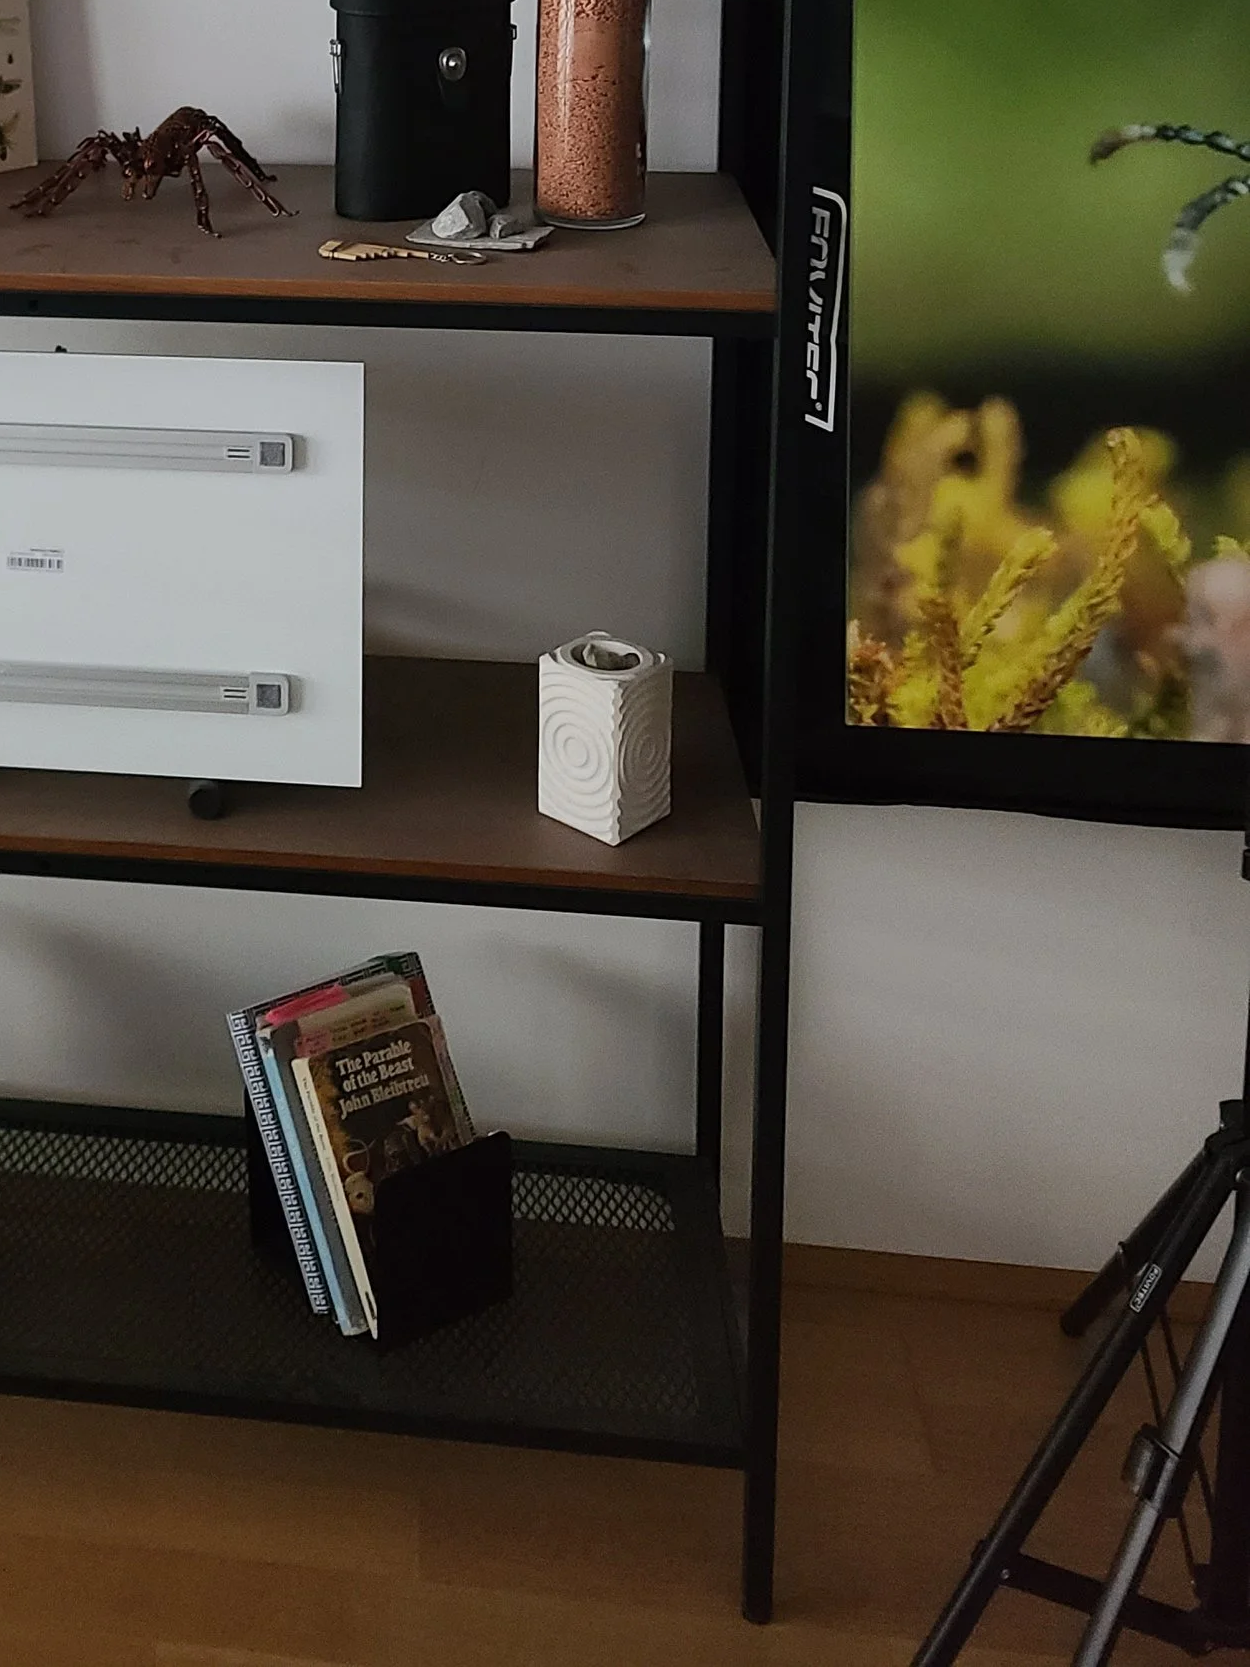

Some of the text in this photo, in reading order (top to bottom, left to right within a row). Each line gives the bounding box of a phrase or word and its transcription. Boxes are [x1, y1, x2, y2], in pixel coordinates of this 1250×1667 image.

[335, 1039, 412, 1076] The Parable
[342, 1057, 415, 1093] of the Beast
[338, 1094, 371, 1121] John
